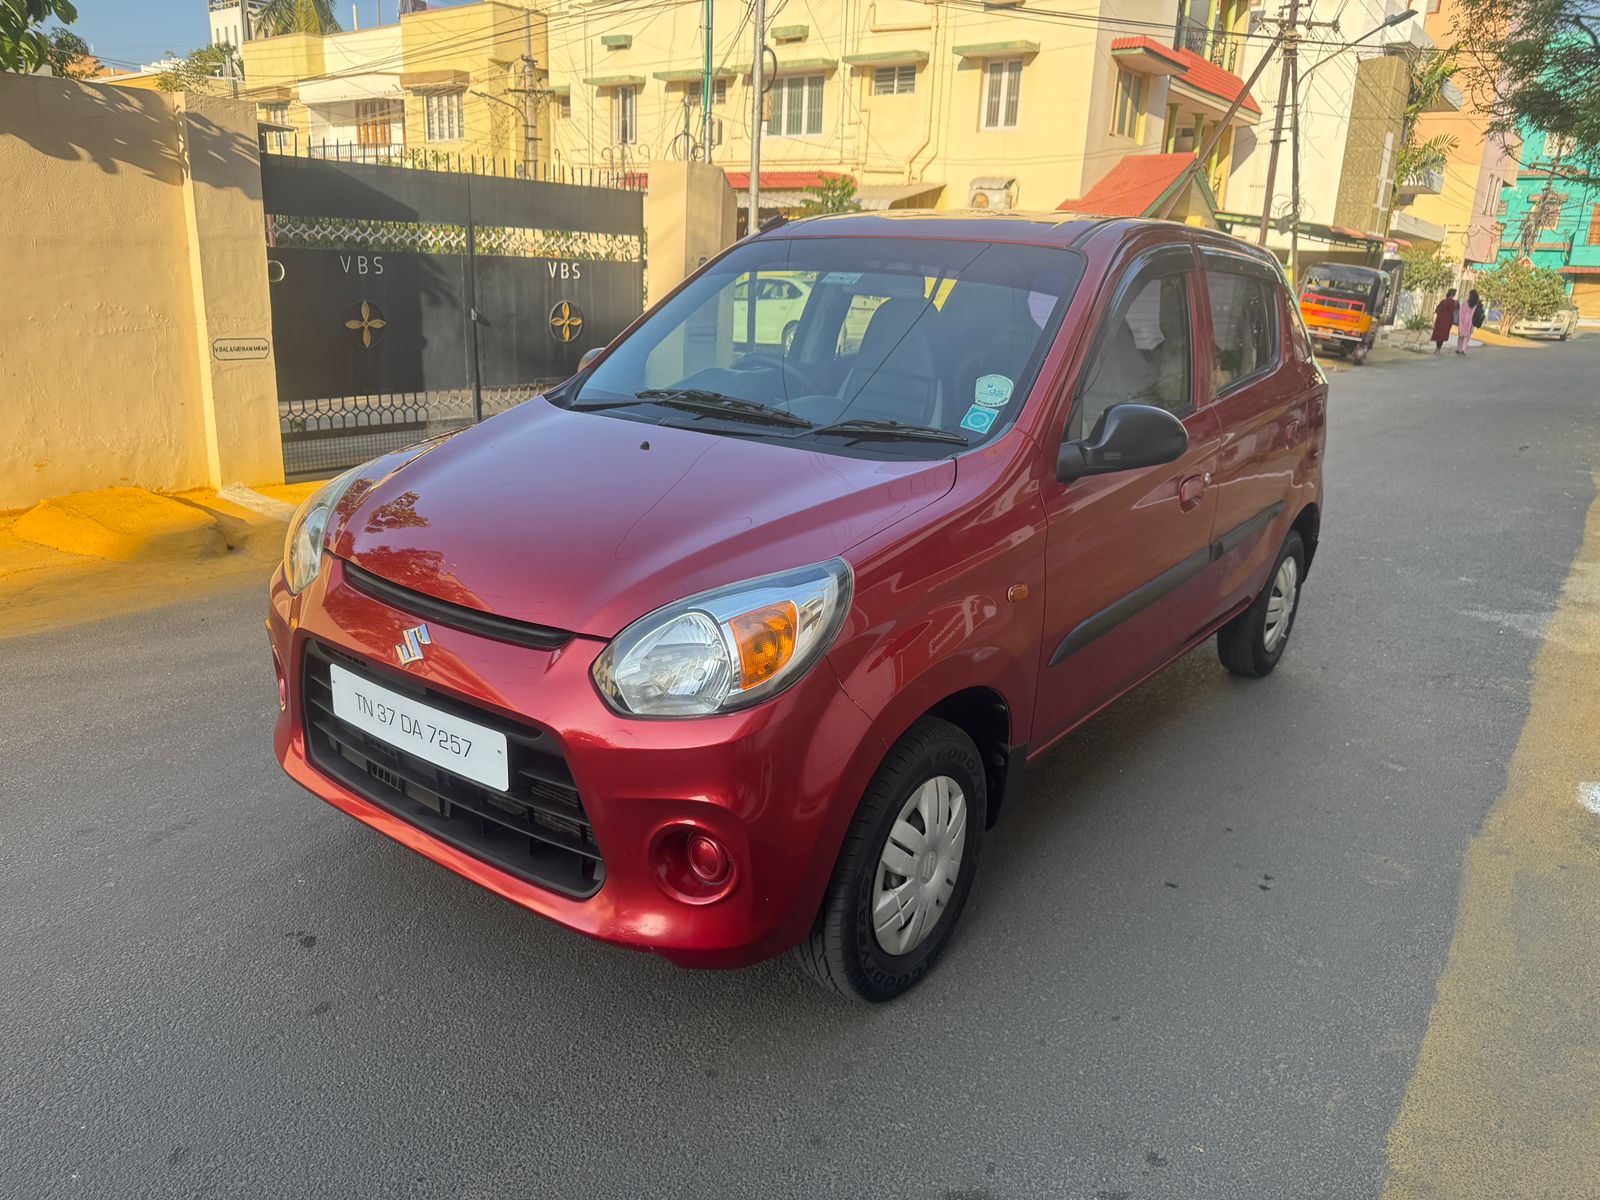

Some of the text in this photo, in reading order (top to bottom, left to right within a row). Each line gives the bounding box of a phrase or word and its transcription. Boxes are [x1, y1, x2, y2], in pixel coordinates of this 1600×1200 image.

[340, 255, 384, 275] VBS
[548, 262, 581, 279] VBS
[355, 692, 472, 758] TN 37 DA 7257
